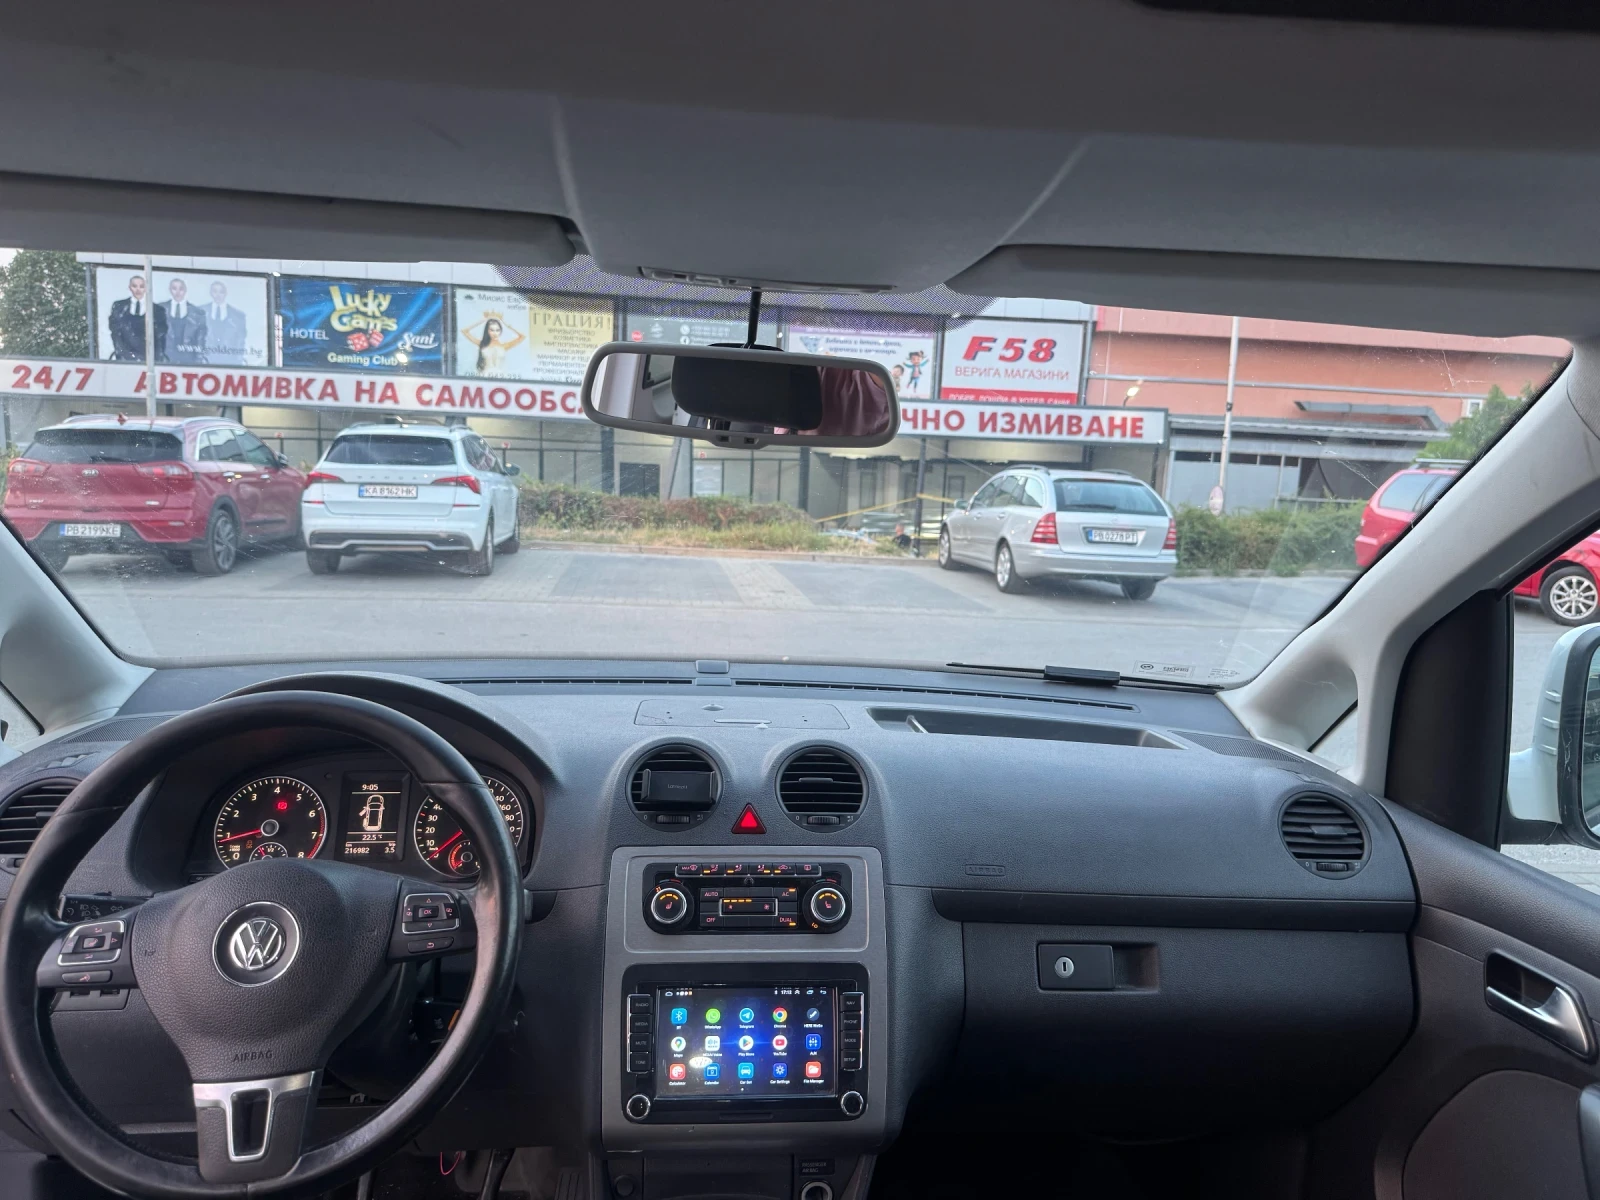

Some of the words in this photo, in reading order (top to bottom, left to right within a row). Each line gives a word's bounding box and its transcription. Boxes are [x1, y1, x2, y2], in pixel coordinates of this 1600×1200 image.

[329, 286, 392, 317] Lucky
[533, 312, 612, 331] ГРАЦИЯ!
[289, 327, 329, 341] HOTEL
[398, 332, 439, 351] Sani
[327, 352, 369, 367] Gaming
[372, 354, 397, 366] Club
[954, 366, 1002, 379] ВЕРИГА
[1004, 368, 1070, 382] МАГАЗИНИ
[12, 364, 95, 393] 24/7
[354, 379, 400, 405] НА
[978, 411, 1144, 438] ИЗМИВАНЕ
[274, 786, 281, 794] 4
[233, 810, 240, 818] 2
[309, 810, 316, 818] 6
[428, 814, 438, 822] 30
[425, 826, 435, 834] 20
[311, 831, 318, 839] 7
[385, 846, 396, 854] 3.5
[233, 852, 240, 860] 0
[298, 851, 305, 859] 8
[233, 1049, 274, 1063] AIRBAG
